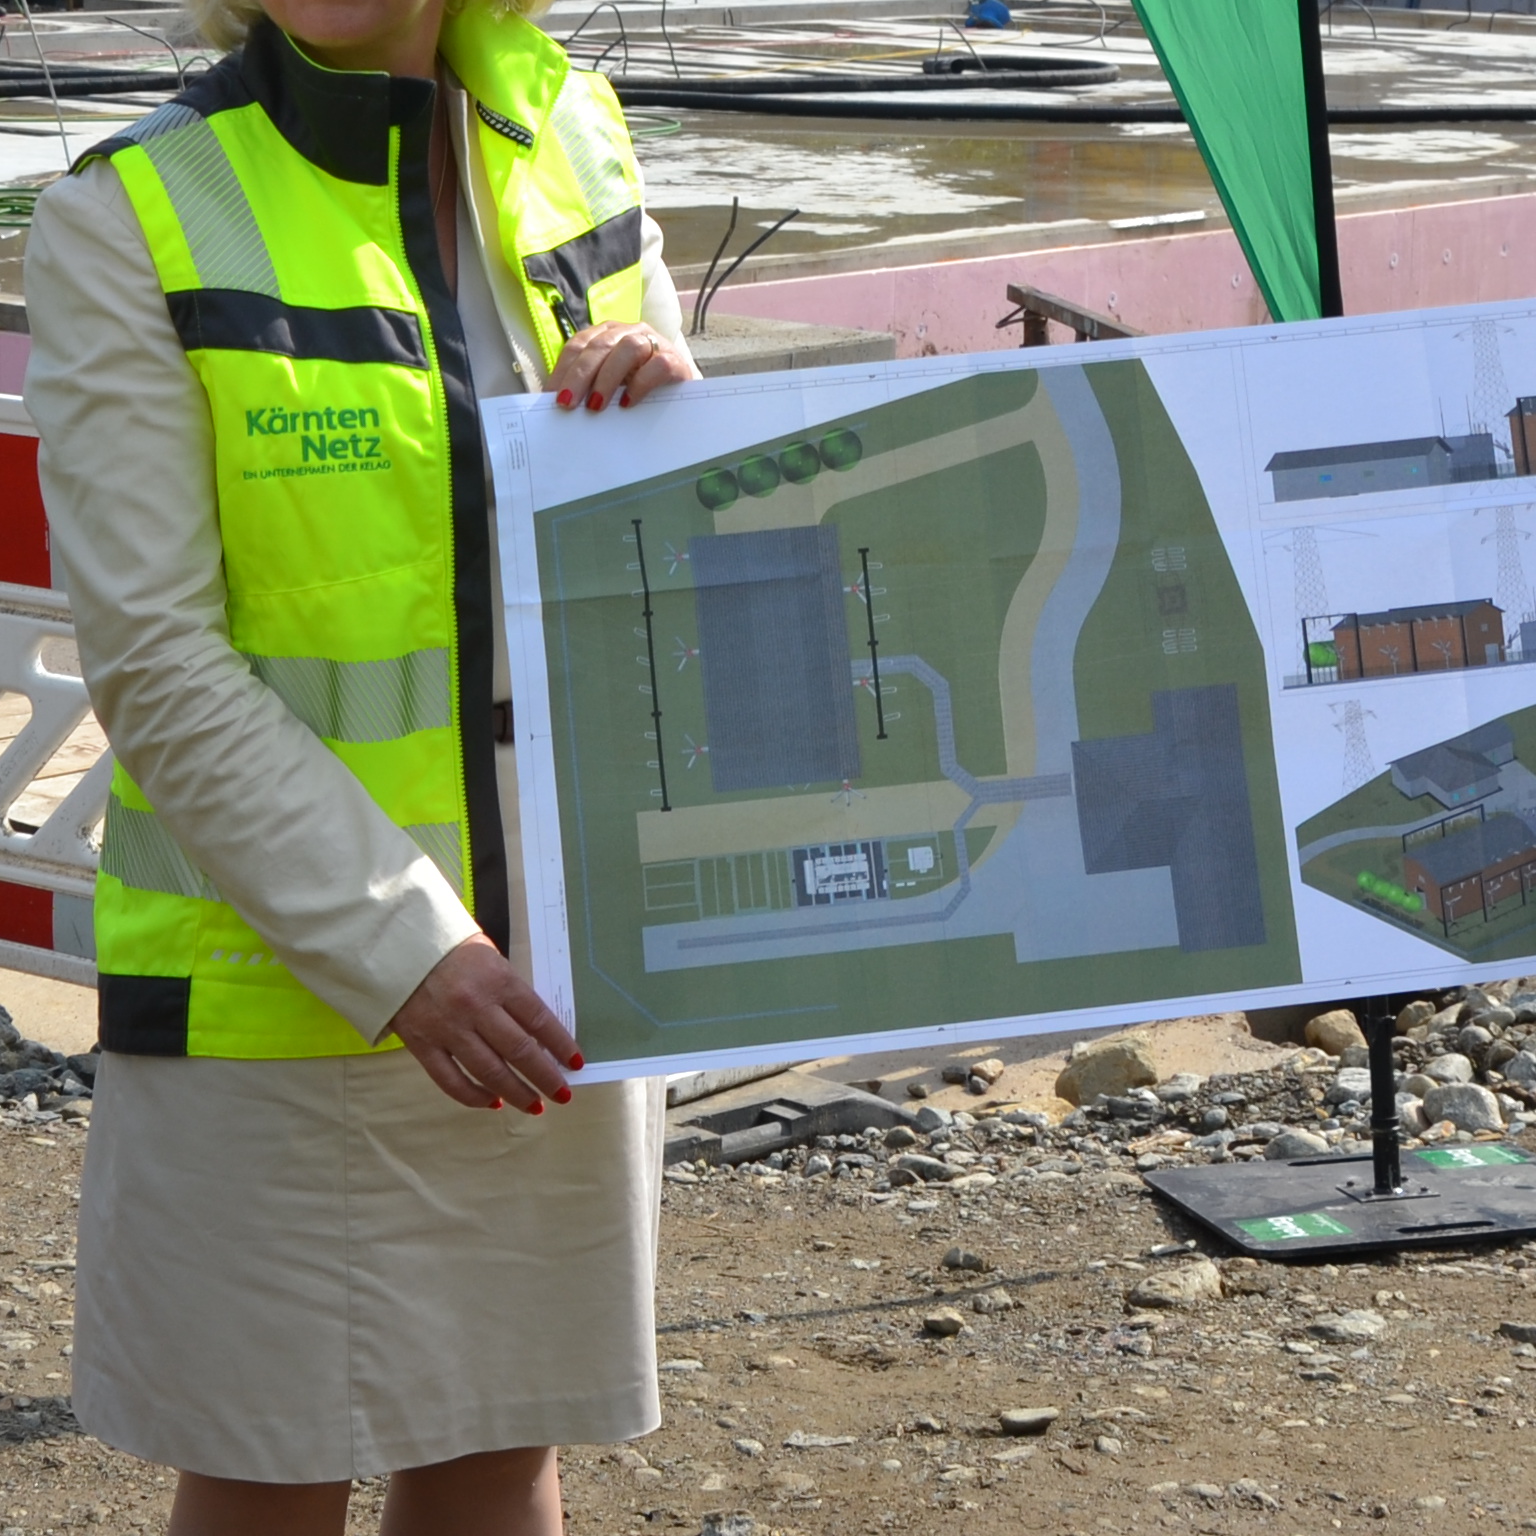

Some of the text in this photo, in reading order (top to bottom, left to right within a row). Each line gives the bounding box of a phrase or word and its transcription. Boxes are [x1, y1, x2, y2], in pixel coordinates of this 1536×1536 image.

[245, 405, 381, 437] Kärnten
[301, 434, 382, 462] Netz
[243, 459, 391, 481] EIN UNTERNEHMEN DER KELAG
